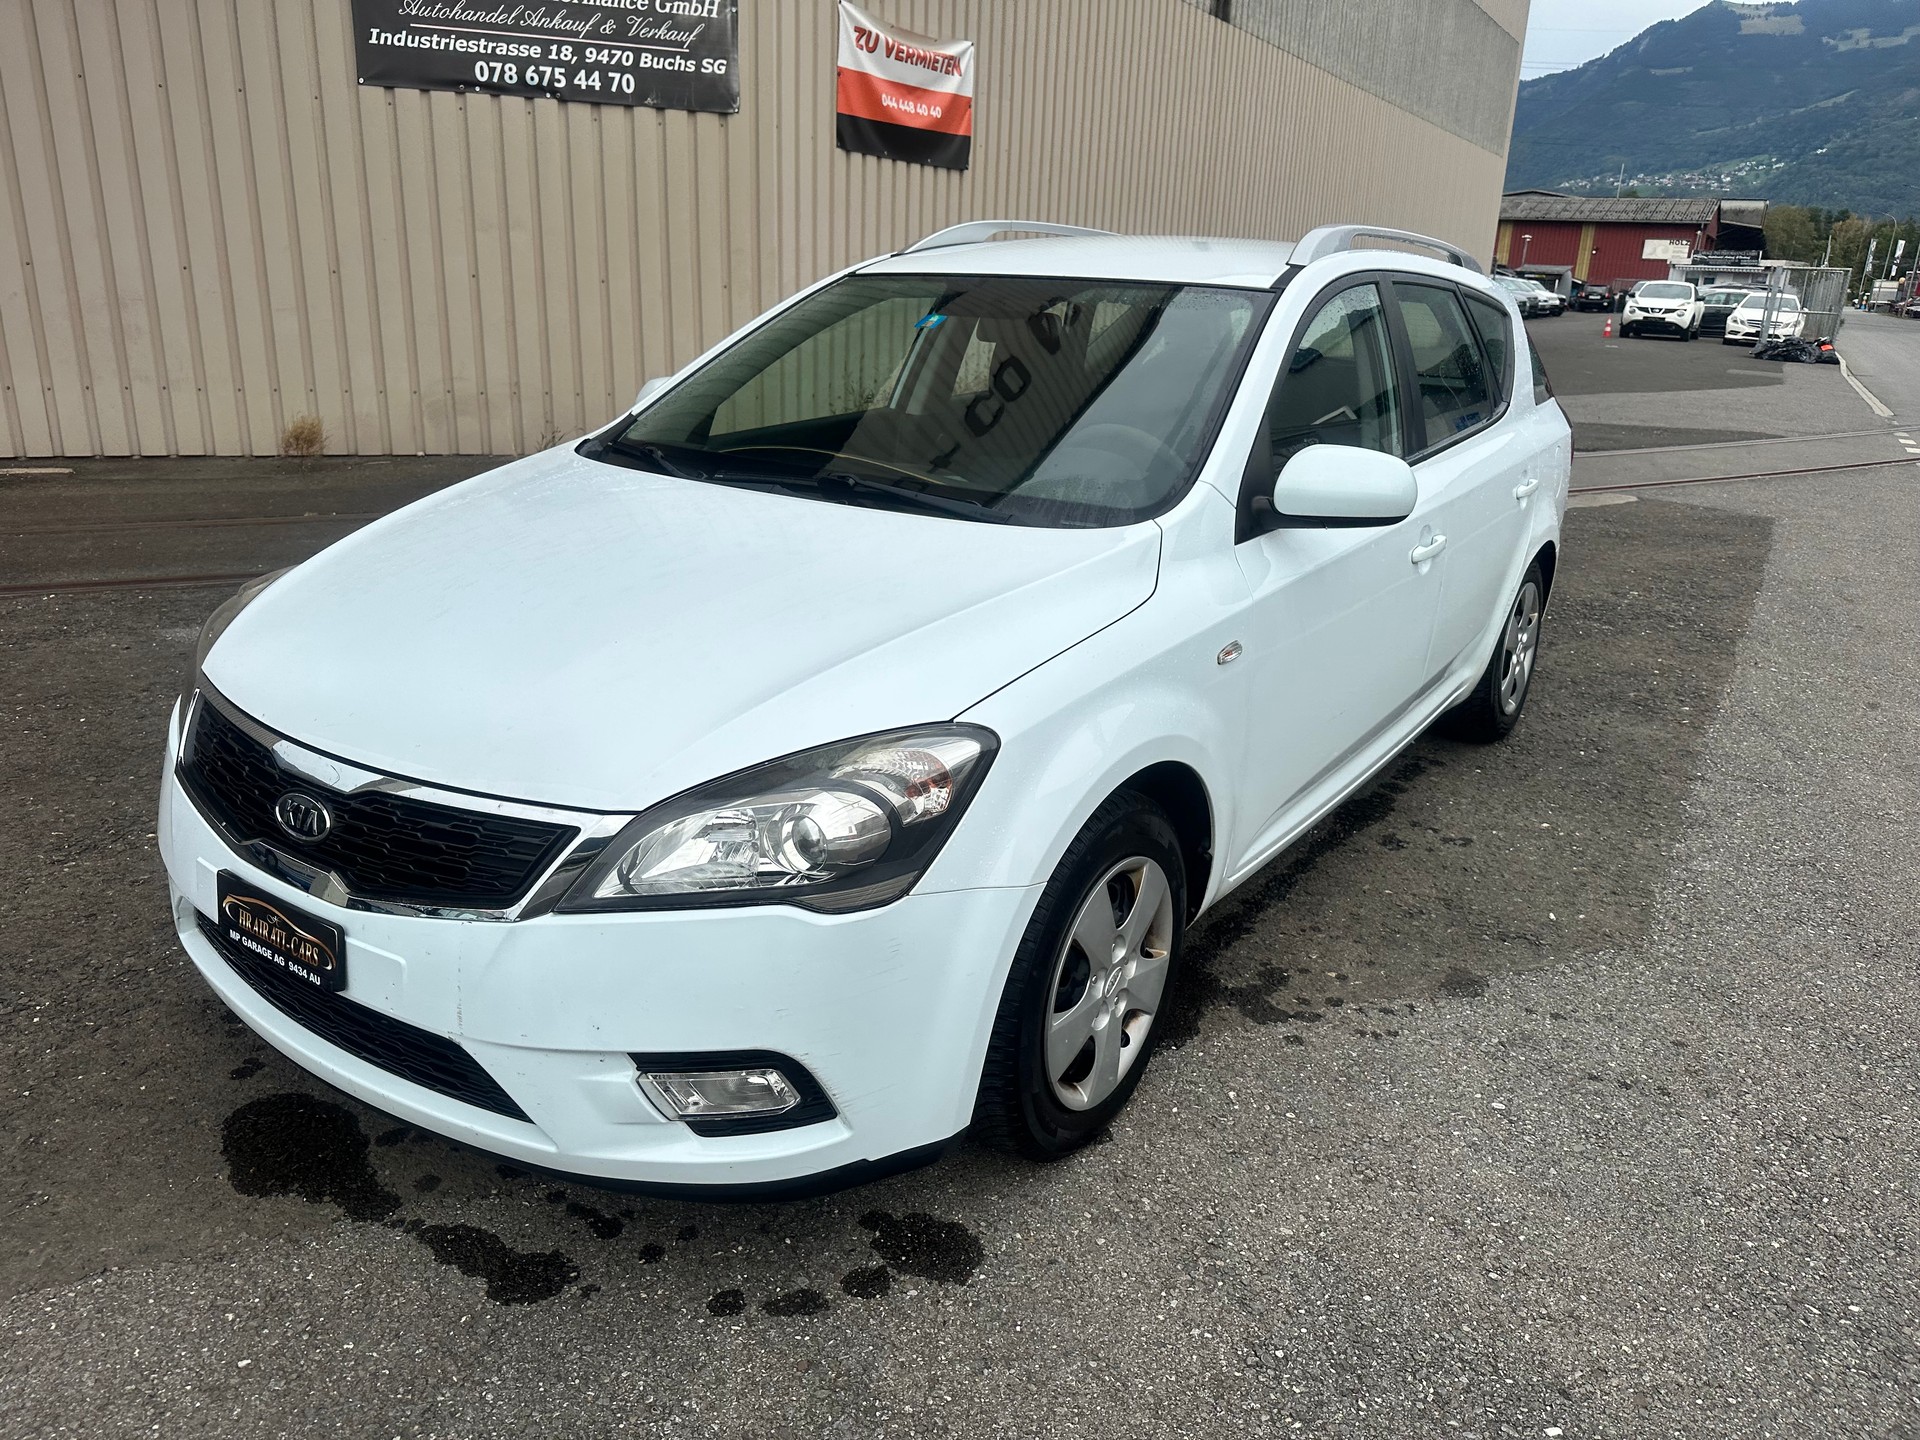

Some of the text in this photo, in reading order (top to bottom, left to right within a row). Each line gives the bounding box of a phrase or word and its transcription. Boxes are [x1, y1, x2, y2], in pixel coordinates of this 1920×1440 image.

[399, 0, 705, 48] Autohandel Ankauf & Verkauf
[655, 0, 720, 18] GmbH
[368, 28, 727, 74] Industriestrasse 18, 9470 Buchs SG
[853, 25, 963, 77] ZU VERMIETEN
[474, 60, 635, 94] 078 675 44 70
[881, 93, 942, 119] 044 448 40 40
[285, 799, 318, 835] KIA
[229, 929, 321, 985] MP GARAGE AG 9434 AU
